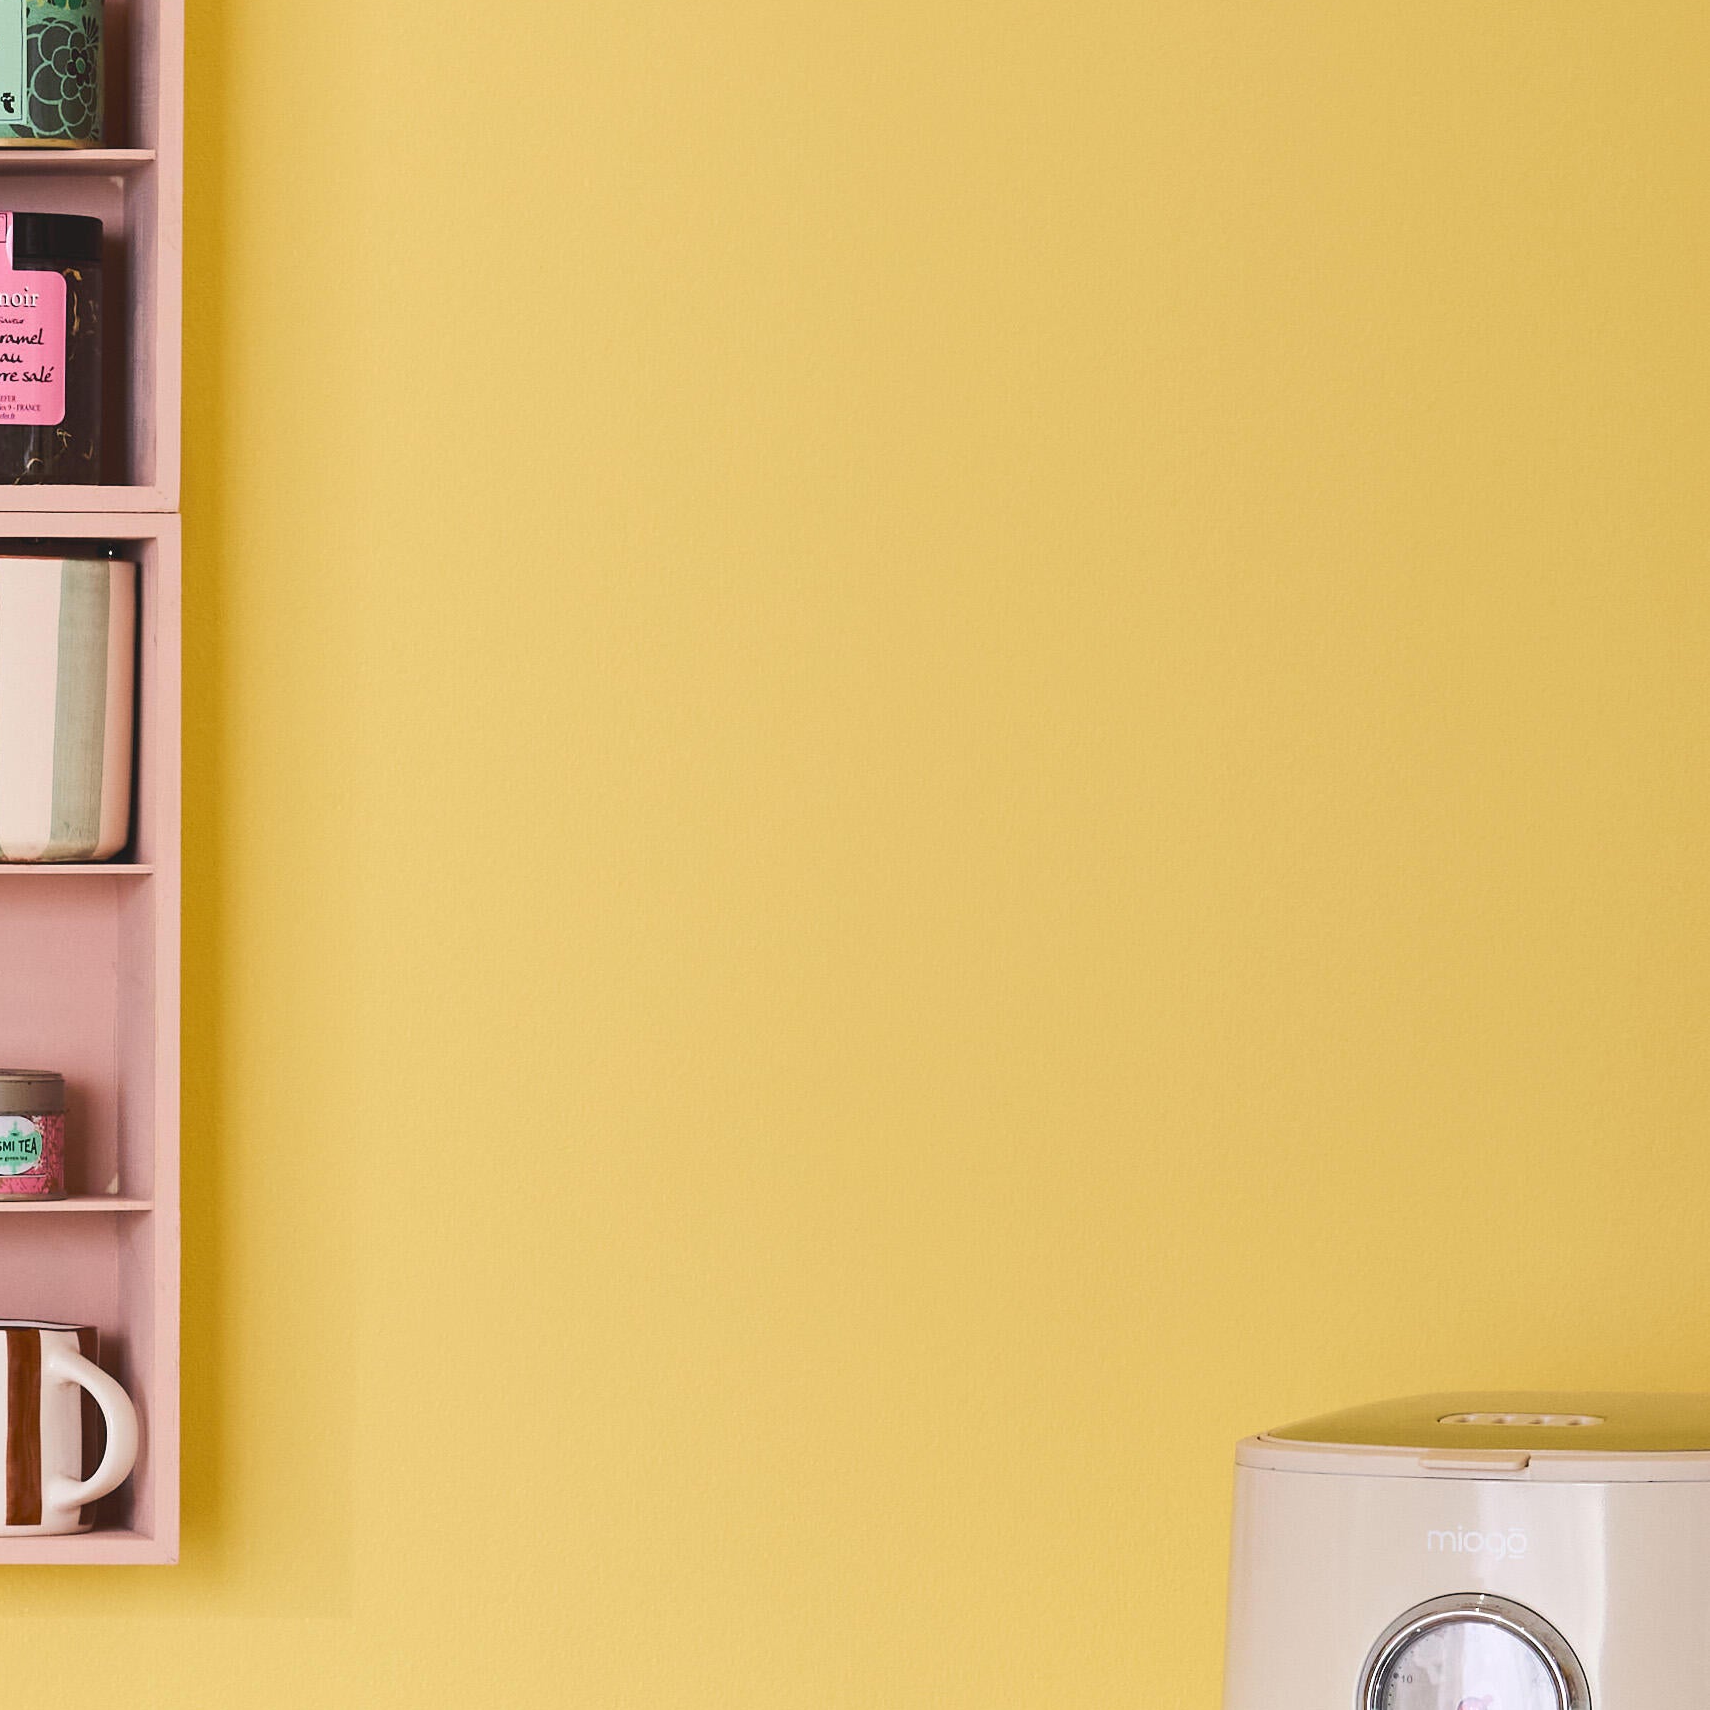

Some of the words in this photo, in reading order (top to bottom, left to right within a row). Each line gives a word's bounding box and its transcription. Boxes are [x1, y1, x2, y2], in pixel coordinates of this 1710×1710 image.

[0, 353, 23, 363] au
[21, 365, 55, 382] salé
[16, 403, 41, 411] FRANCE
[18, 1137, 38, 1155] TEA
[1401, 1675, 1413, 1684] 10
